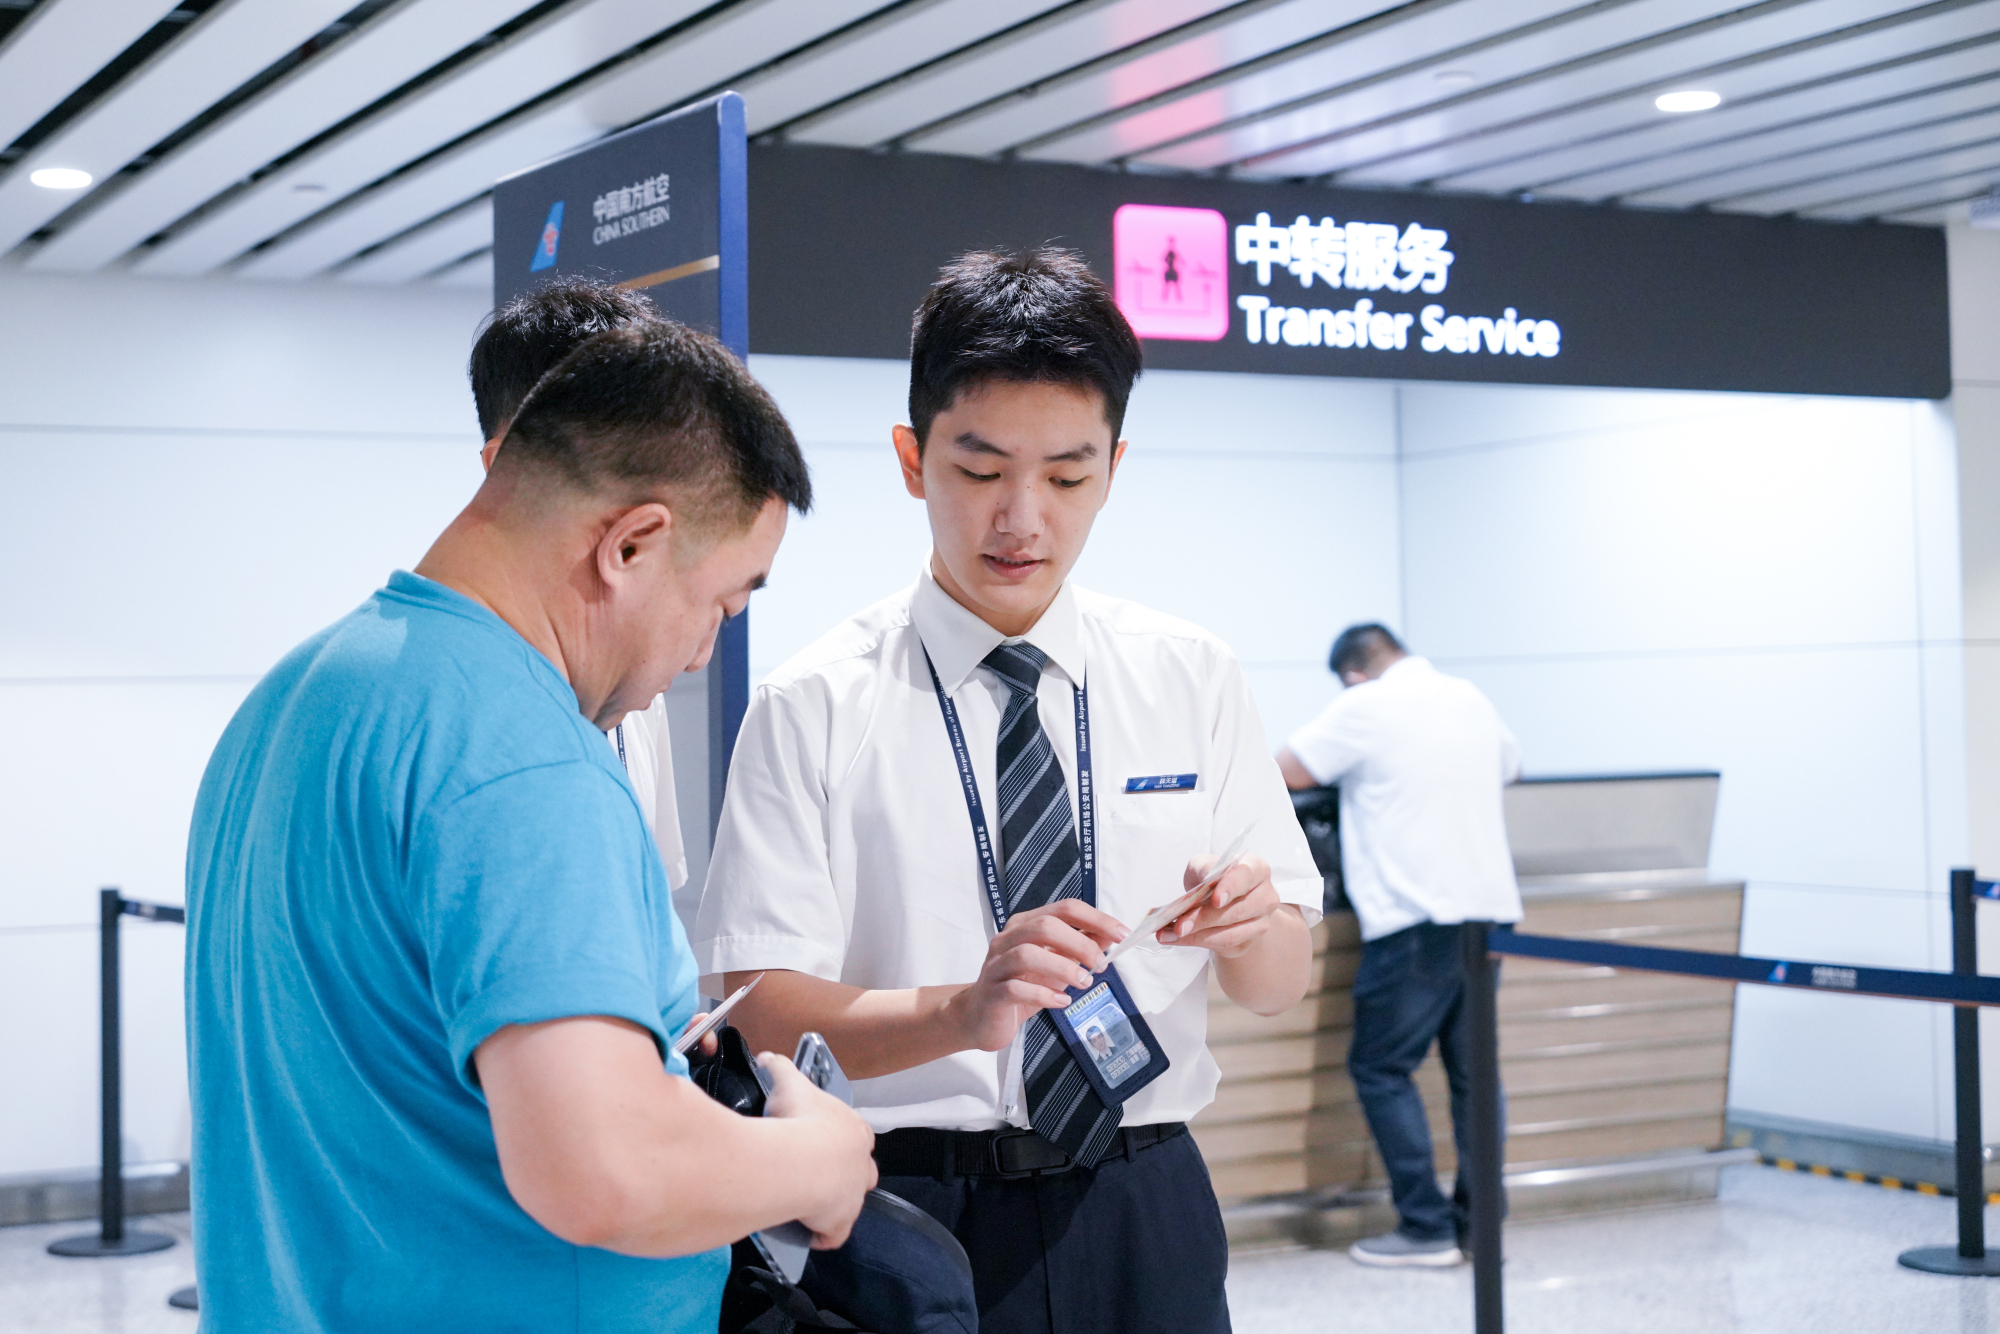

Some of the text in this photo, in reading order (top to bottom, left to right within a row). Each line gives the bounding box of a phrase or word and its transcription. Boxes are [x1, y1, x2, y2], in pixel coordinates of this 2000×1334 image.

[593, 172, 670, 224] 中国南方航空
[592, 203, 670, 246] CHINA SOUTHERN
[1234, 211, 1455, 294] 中转服务
[1236, 294, 1562, 358] Transfer Service
[1078, 696, 1086, 720] Airport
[952, 724, 962, 748] Bureau
[1079, 721, 1087, 730] by
[957, 748, 968, 773] Airport
[965, 774, 972, 783] by
[1081, 770, 1093, 875] 东省公安厅机场公安局制发
